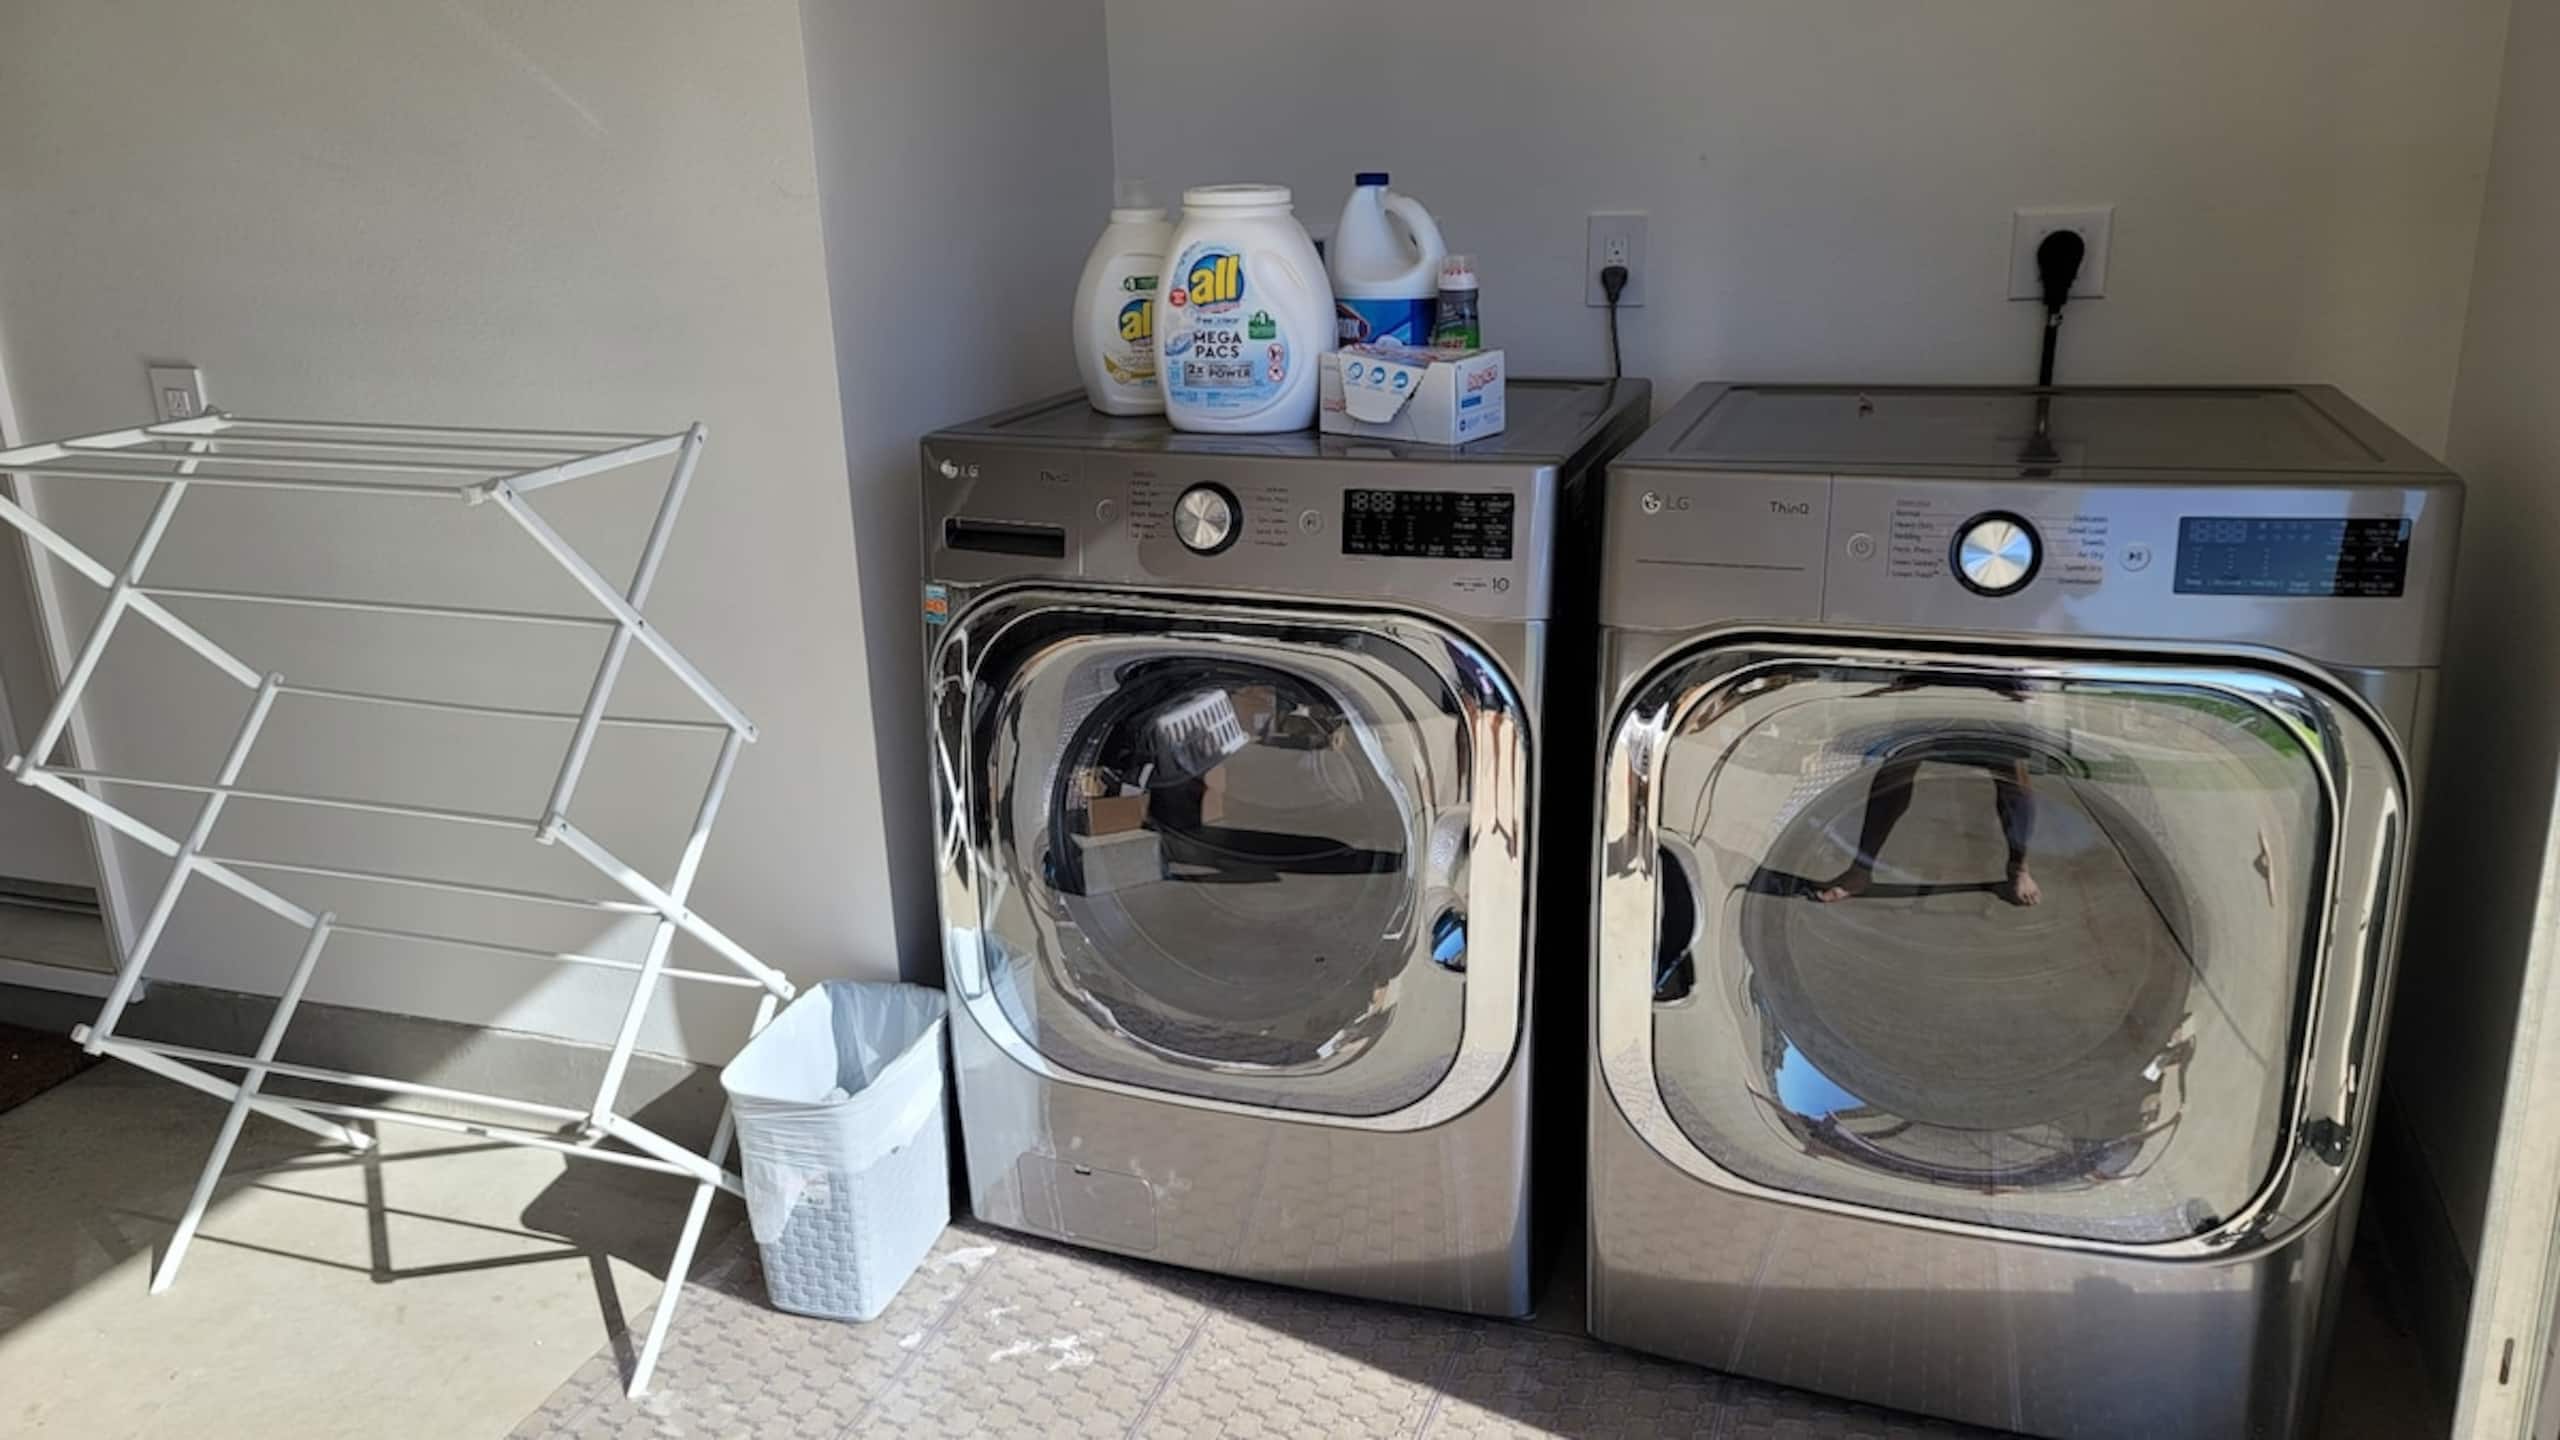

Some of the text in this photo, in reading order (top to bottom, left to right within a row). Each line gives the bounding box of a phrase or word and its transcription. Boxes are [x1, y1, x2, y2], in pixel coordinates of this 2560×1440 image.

[1190, 254, 1239, 306] all
[1120, 300, 1153, 341] al
[1193, 330, 1242, 344] MEGA
[1195, 345, 1240, 358] PACS
[1208, 368, 1250, 378] POWER
[960, 464, 979, 477] LG
[1666, 496, 1690, 511] LG
[1770, 501, 1810, 515] ThinQ
[1492, 577, 1510, 592] 10
